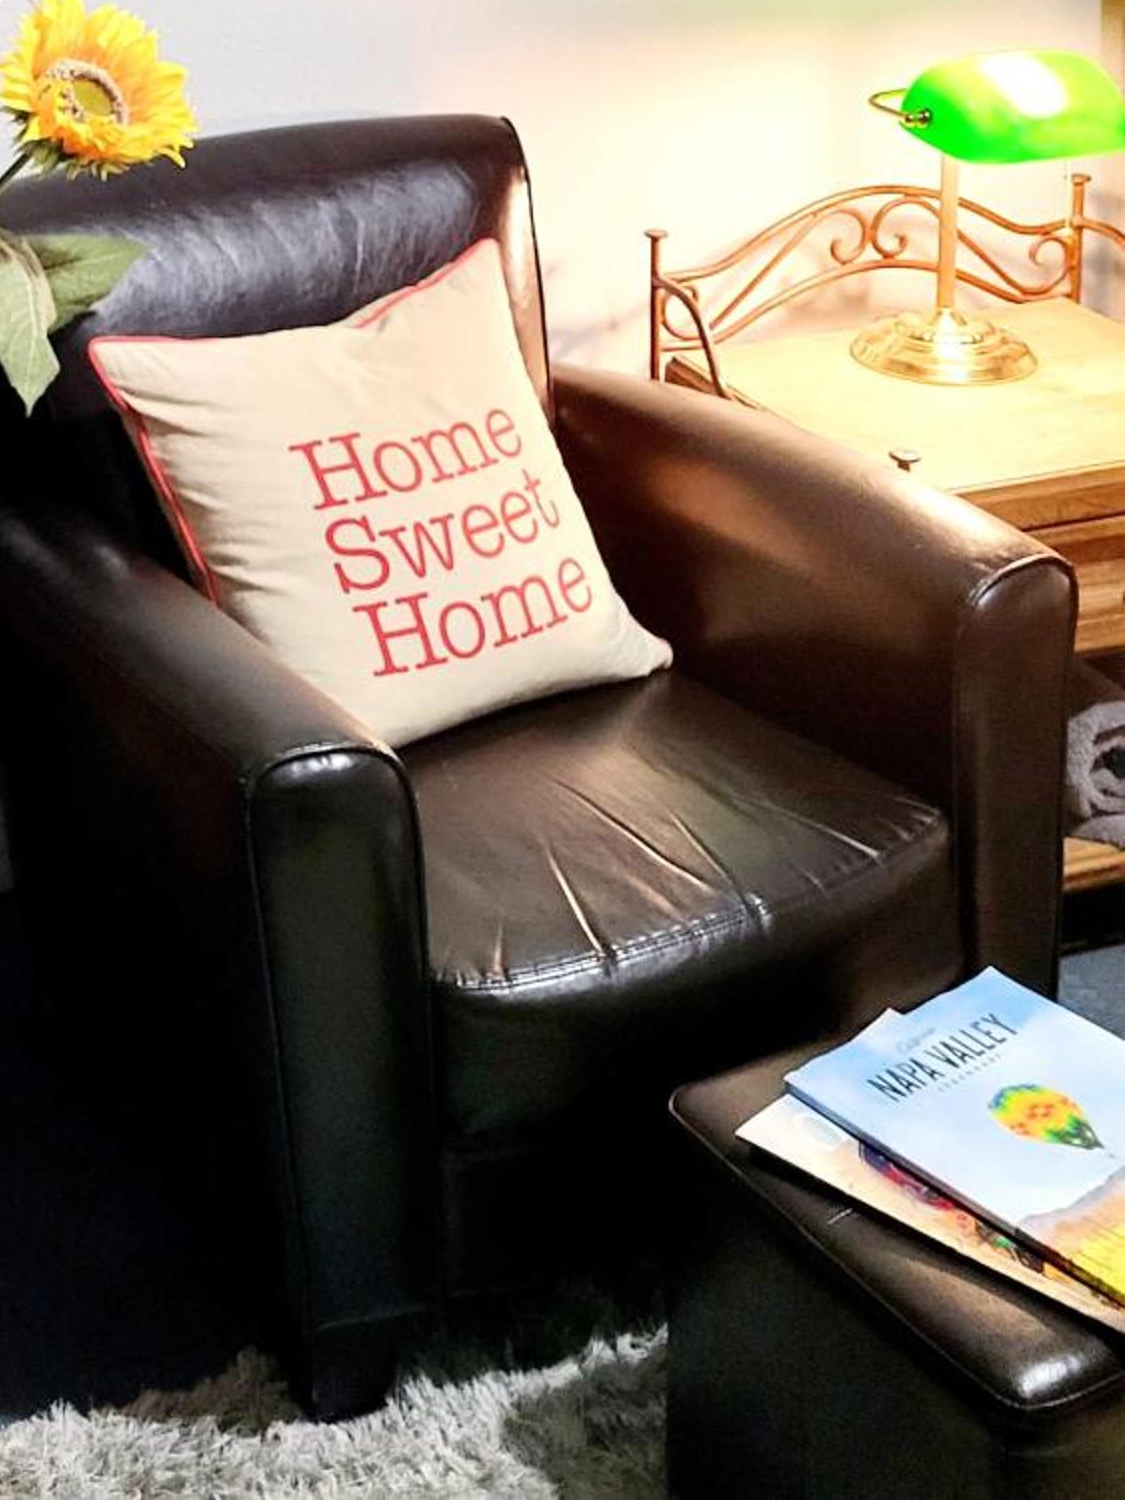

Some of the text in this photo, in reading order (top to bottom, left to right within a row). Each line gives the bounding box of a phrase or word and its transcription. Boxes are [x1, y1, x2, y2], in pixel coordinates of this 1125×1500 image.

[288, 407, 523, 511] Home
[324, 467, 561, 594] Sweet
[352, 557, 594, 678] Home
[866, 1057, 945, 1103] NAPA
[923, 1012, 1019, 1069] VALLEY
